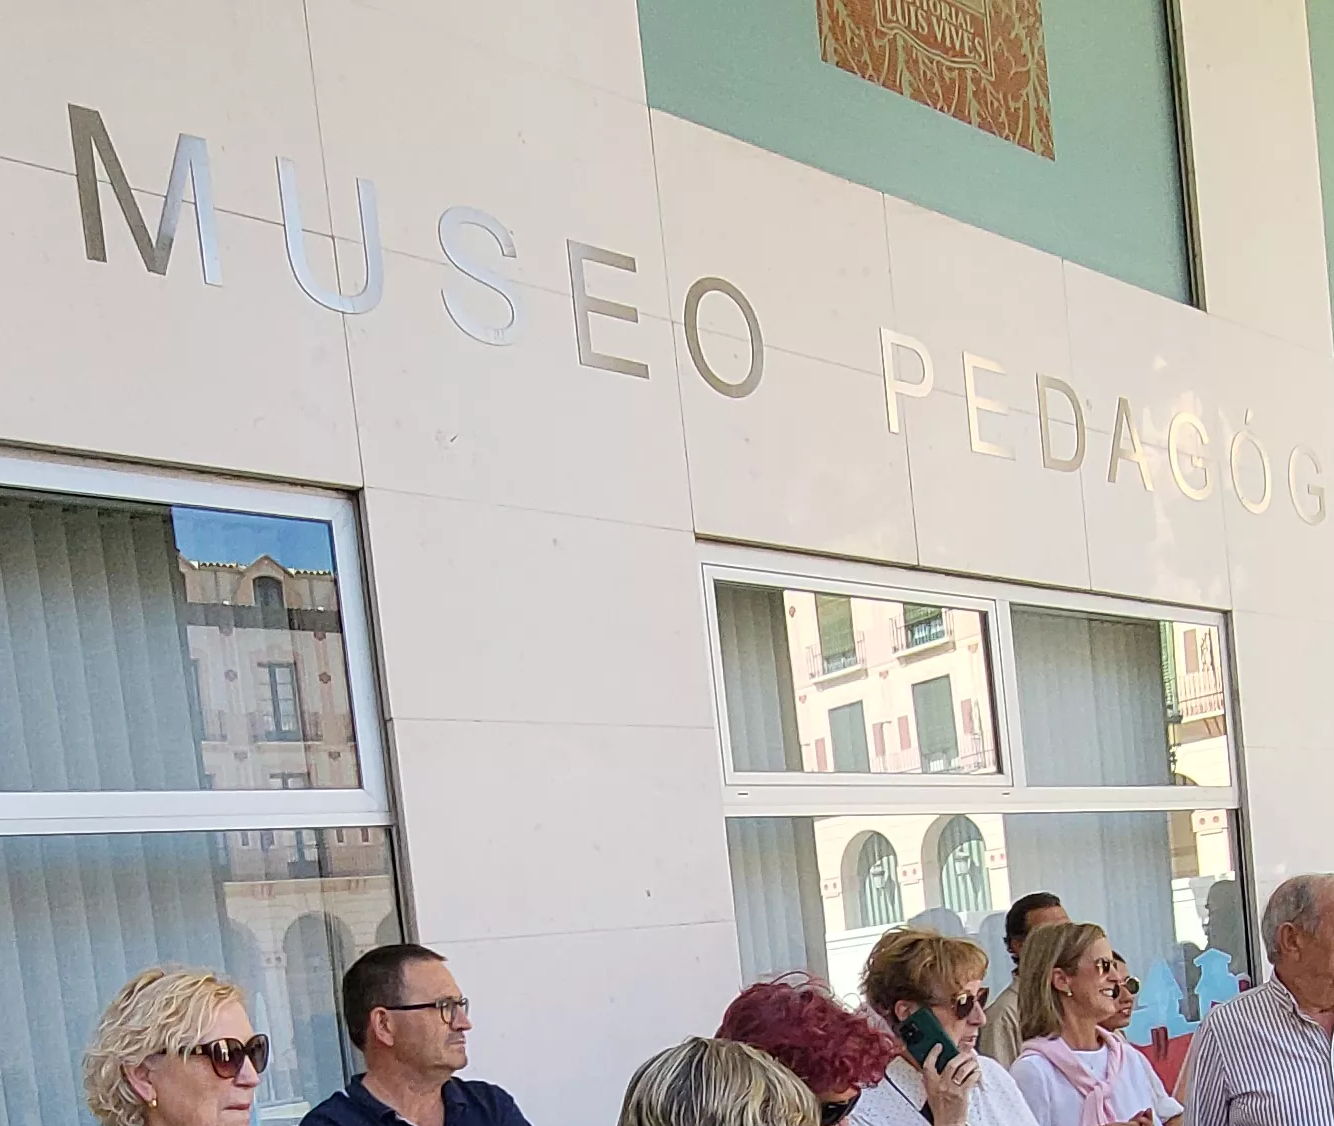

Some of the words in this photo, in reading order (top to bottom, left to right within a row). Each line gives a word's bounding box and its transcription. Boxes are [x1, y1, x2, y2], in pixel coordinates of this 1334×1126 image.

[886, 0, 928, 34] LUIS
[931, 15, 984, 61] VIVES
[67, 102, 765, 399] MUSEO
